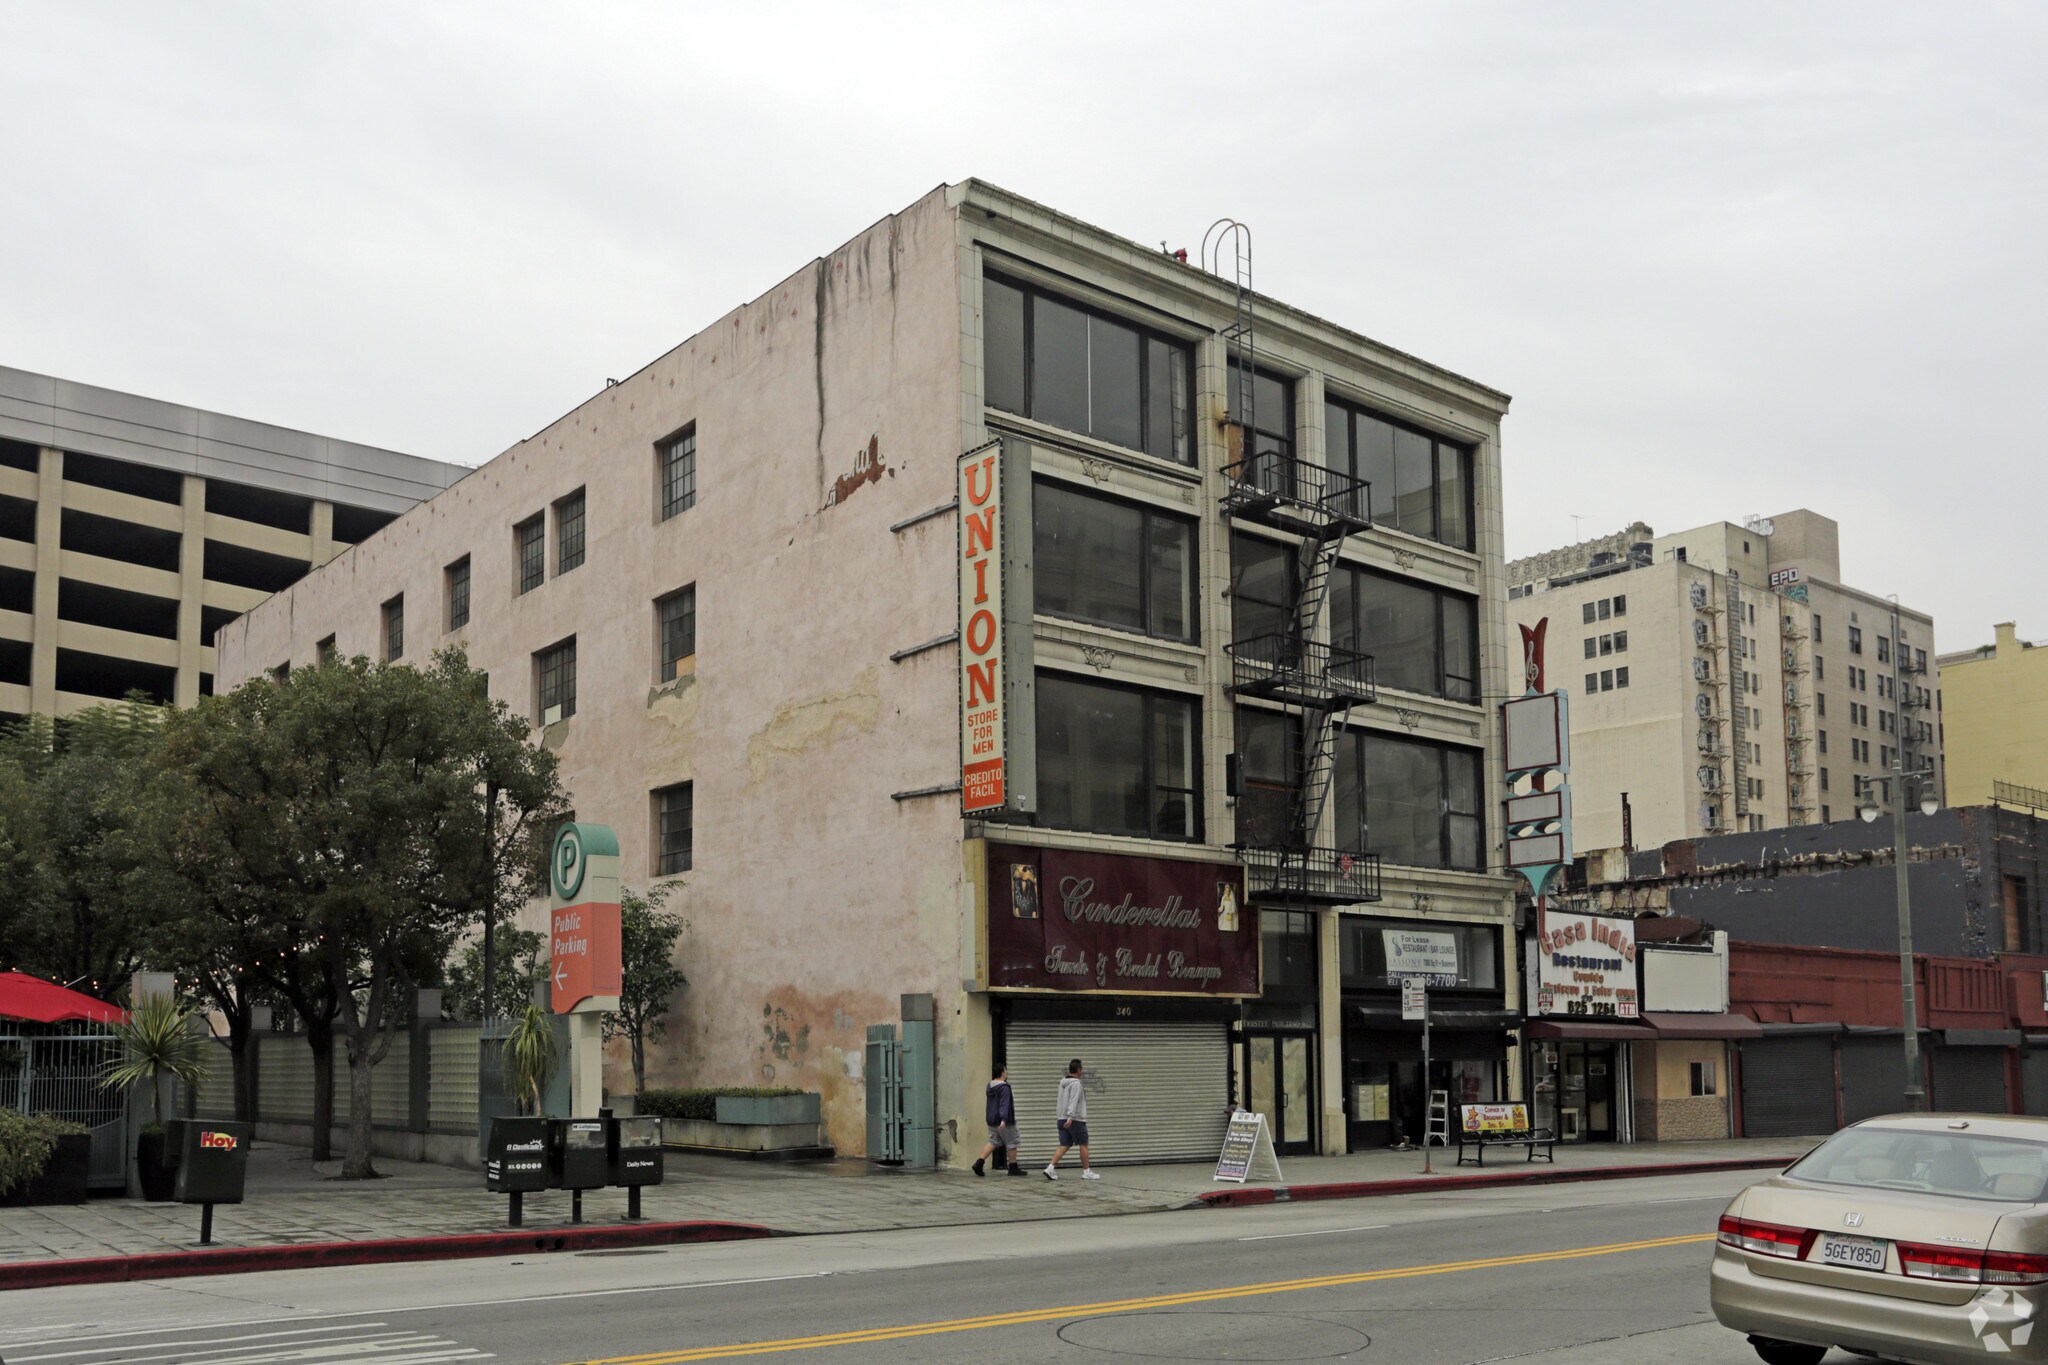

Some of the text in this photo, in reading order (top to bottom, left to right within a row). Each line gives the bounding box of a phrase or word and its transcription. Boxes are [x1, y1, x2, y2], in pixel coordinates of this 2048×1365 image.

[964, 455, 998, 708] UNION
[968, 708, 998, 727] STORE
[973, 725, 993, 740] FOR
[972, 739, 994, 755] MEN
[964, 768, 1003, 787] CREDITO
[970, 783, 997, 799] FACIL
[1059, 875, 1202, 929] Cinderellas
[554, 912, 581, 933] Public
[554, 936, 587, 956] Parking
[1401, 935, 1430, 944] For Lease
[1402, 944, 1428, 953] RESTAURANT
[1540, 918, 1636, 963] Casa India
[1539, 993, 1553, 1002] ATM
[1568, 1000, 1616, 1015] 625 1264
[1619, 1003, 1637, 1015] ATM
[201, 1131, 237, 1151] Hoy
[1824, 1243, 1881, 1264] 5GEY850
